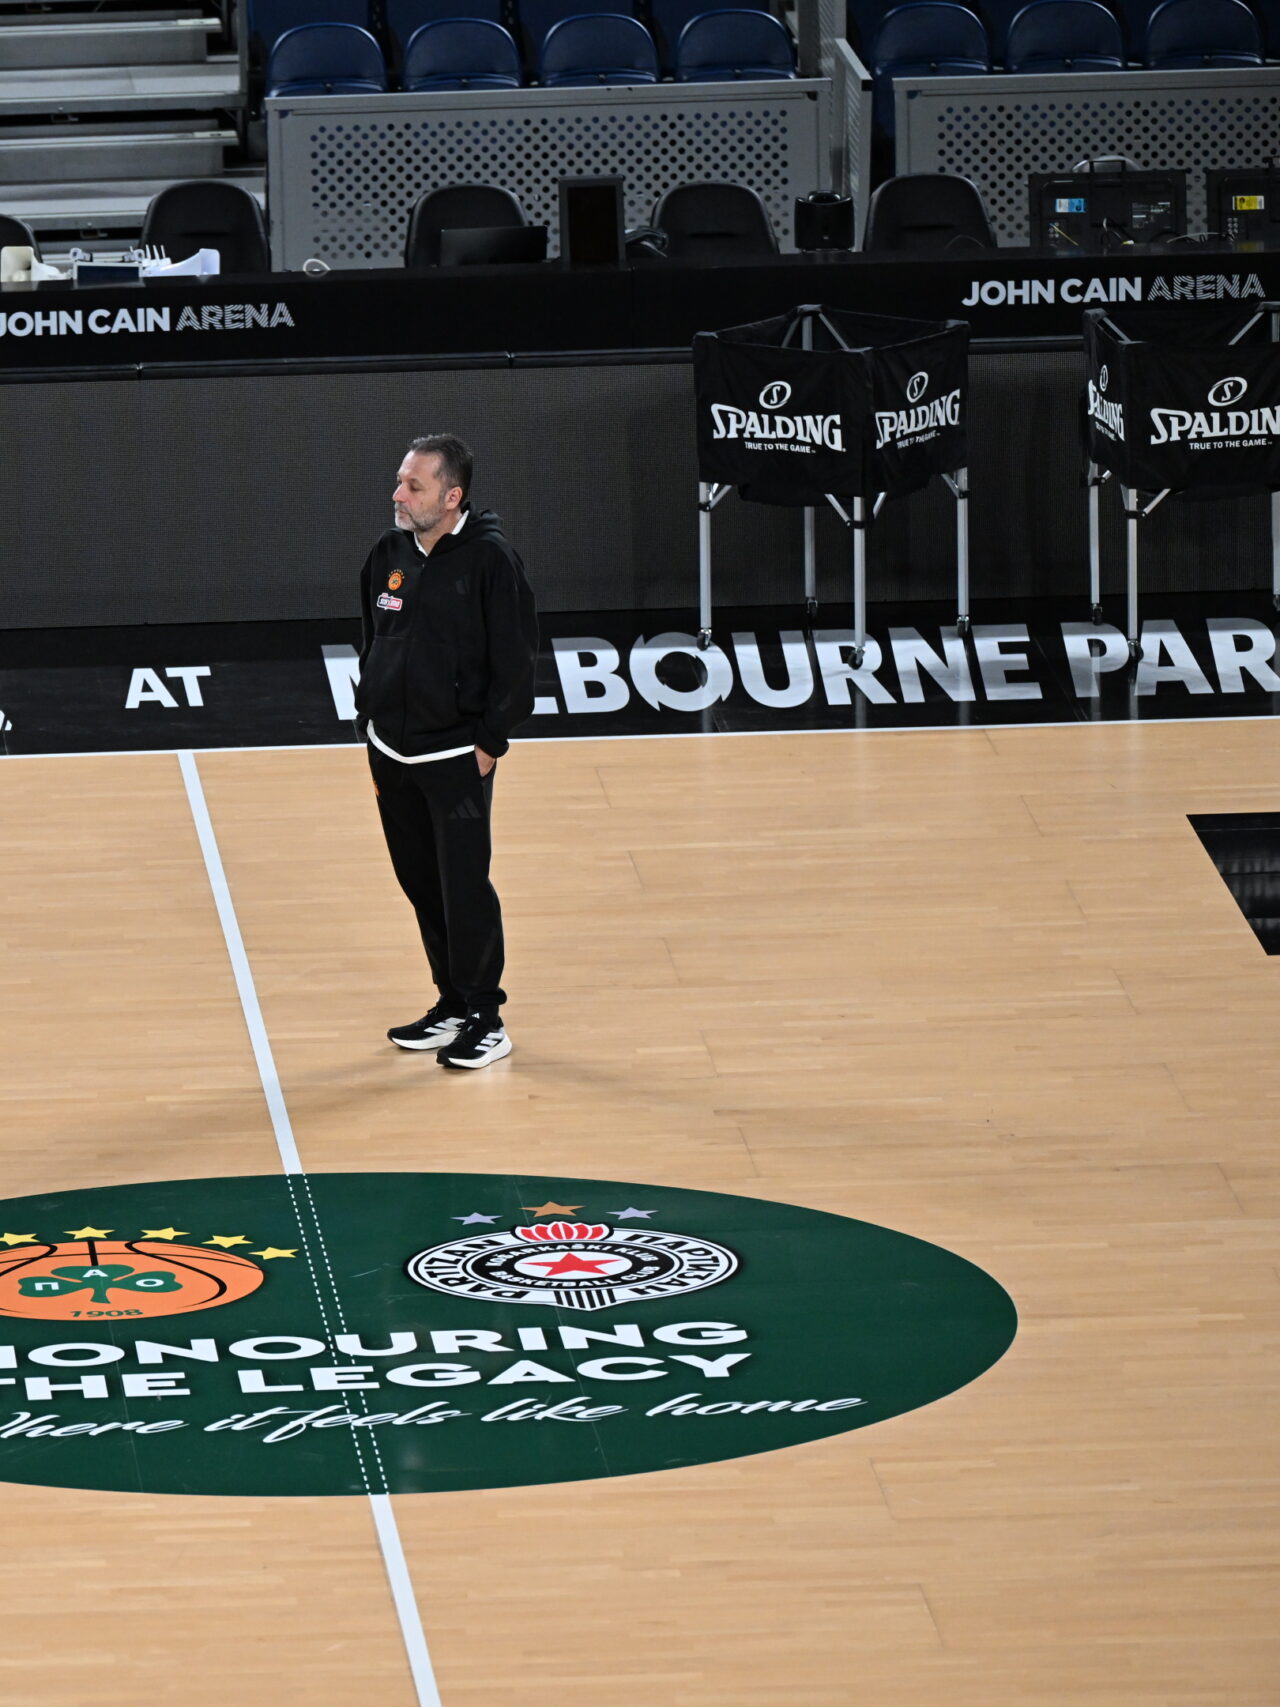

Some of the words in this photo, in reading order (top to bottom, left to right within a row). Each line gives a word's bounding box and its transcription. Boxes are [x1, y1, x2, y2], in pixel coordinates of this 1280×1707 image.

[961, 279, 1055, 306] JOHN
[1060, 277, 1142, 303] CAIN
[1147, 273, 1266, 301] ARENA
[87, 307, 170, 334] CAIN
[175, 303, 295, 331] ARENA
[710, 403, 846, 452] SPALDING
[875, 389, 961, 450] SPALDING
[1087, 379, 1126, 441] SPALDING
[745, 441, 763, 451] TRUE
[764, 443, 774, 451] TO
[775, 443, 789, 452] THE
[789, 444, 811, 454] GAME
[1189, 442, 1212, 450] TRUE
[1213, 441, 1223, 449] TO
[1224, 440, 1241, 448] THE
[1242, 438, 1267, 447] GAME
[124, 665, 212, 709] AT
[321, 624, 1043, 721] BOURNE
[424, 1239, 530, 1299] PARTIZAN
[614, 1247, 659, 1262] KLUB
[626, 1233, 721, 1296] ПАРТИЗАН
[489, 1270, 622, 1287] BASKETBALL
[621, 1265, 661, 1281] CLUB
[70, 1309, 144, 1319] 1908
[237, 1352, 752, 1394] LEGACY
[204, 1406, 292, 1431] it
[263, 1399, 472, 1443] feels
[480, 1395, 629, 1423] like
[645, 1392, 868, 1418] home
